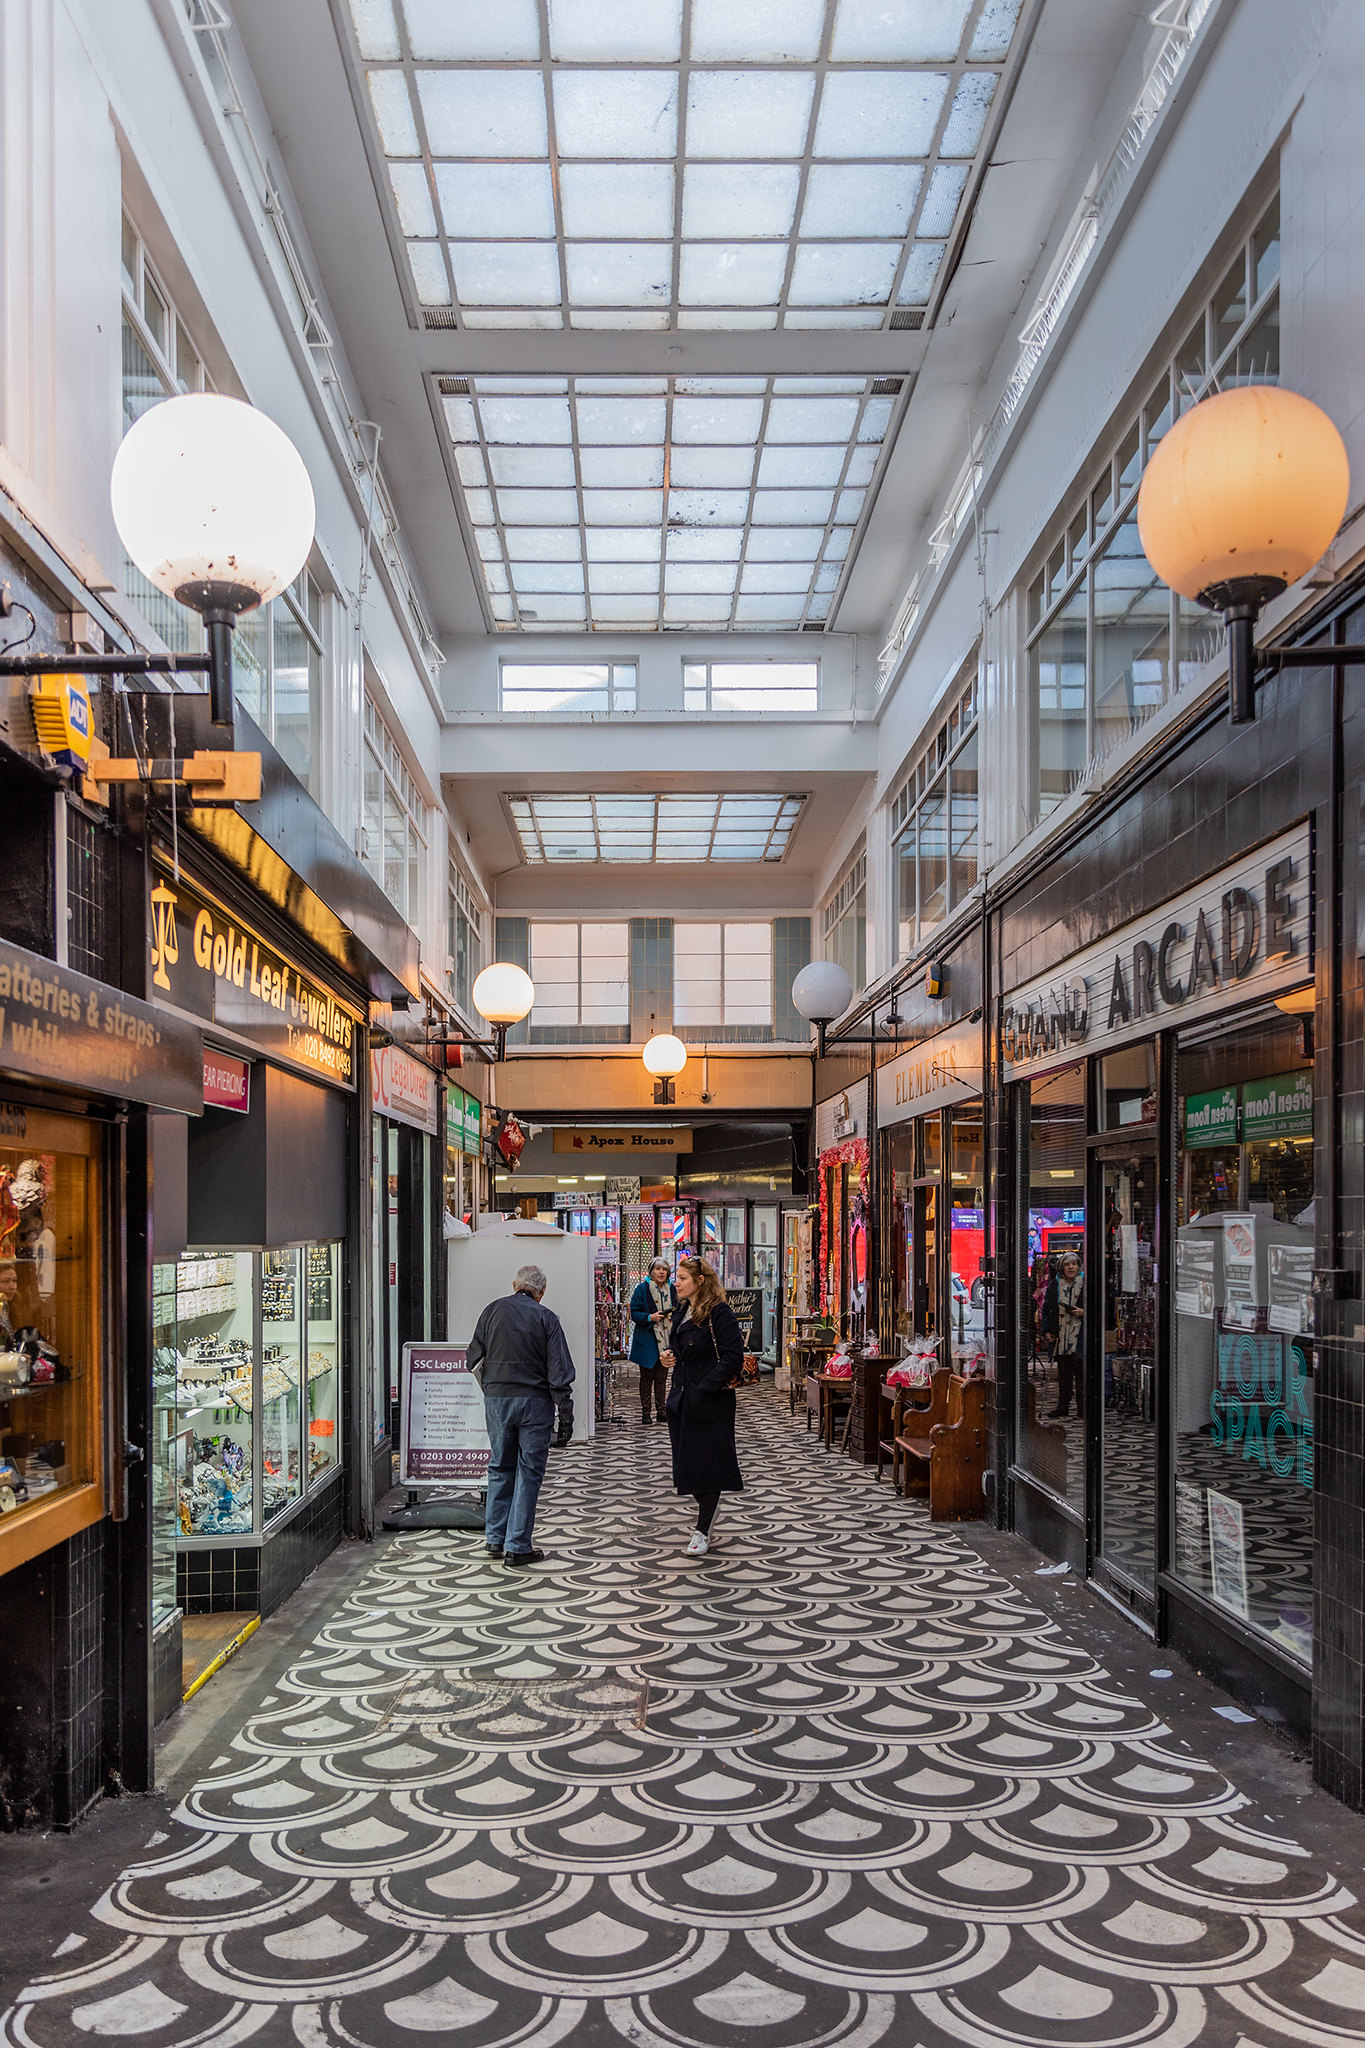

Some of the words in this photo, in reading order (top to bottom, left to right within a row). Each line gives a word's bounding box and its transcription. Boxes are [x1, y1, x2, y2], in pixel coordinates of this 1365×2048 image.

[71, 698, 87, 729] ADT
[193, 908, 248, 989] Gold
[249, 943, 290, 1012] Leaf
[290, 975, 352, 1049] Jewellers
[1001, 975, 1089, 1063] GRAND
[1107, 856, 1292, 1030] ARCADE
[0, 961, 81, 1022] atteries
[86, 990, 100, 1029] &
[104, 1003, 155, 1050] straps
[304, 1032, 318, 1061] 020
[336, 1048, 351, 1076] 0493
[895, 1045, 957, 1106] ELEMENTS
[204, 1064, 217, 1088] EAR
[217, 1069, 246, 1097] PIERCING
[373, 1047, 389, 1107] SC
[390, 1049, 409, 1097] Legal
[410, 1062, 428, 1101] Direct
[588, 1135, 624, 1148] Apex
[631, 1135, 675, 1146] House
[743, 1321, 754, 1329] CUT
[414, 1359, 433, 1369] SSC
[434, 1359, 462, 1371] Legal
[1217, 1330, 1309, 1417] YOUR
[420, 1452, 443, 1460] 0203
[445, 1452, 463, 1460] 092
[465, 1452, 489, 1460] 4949
